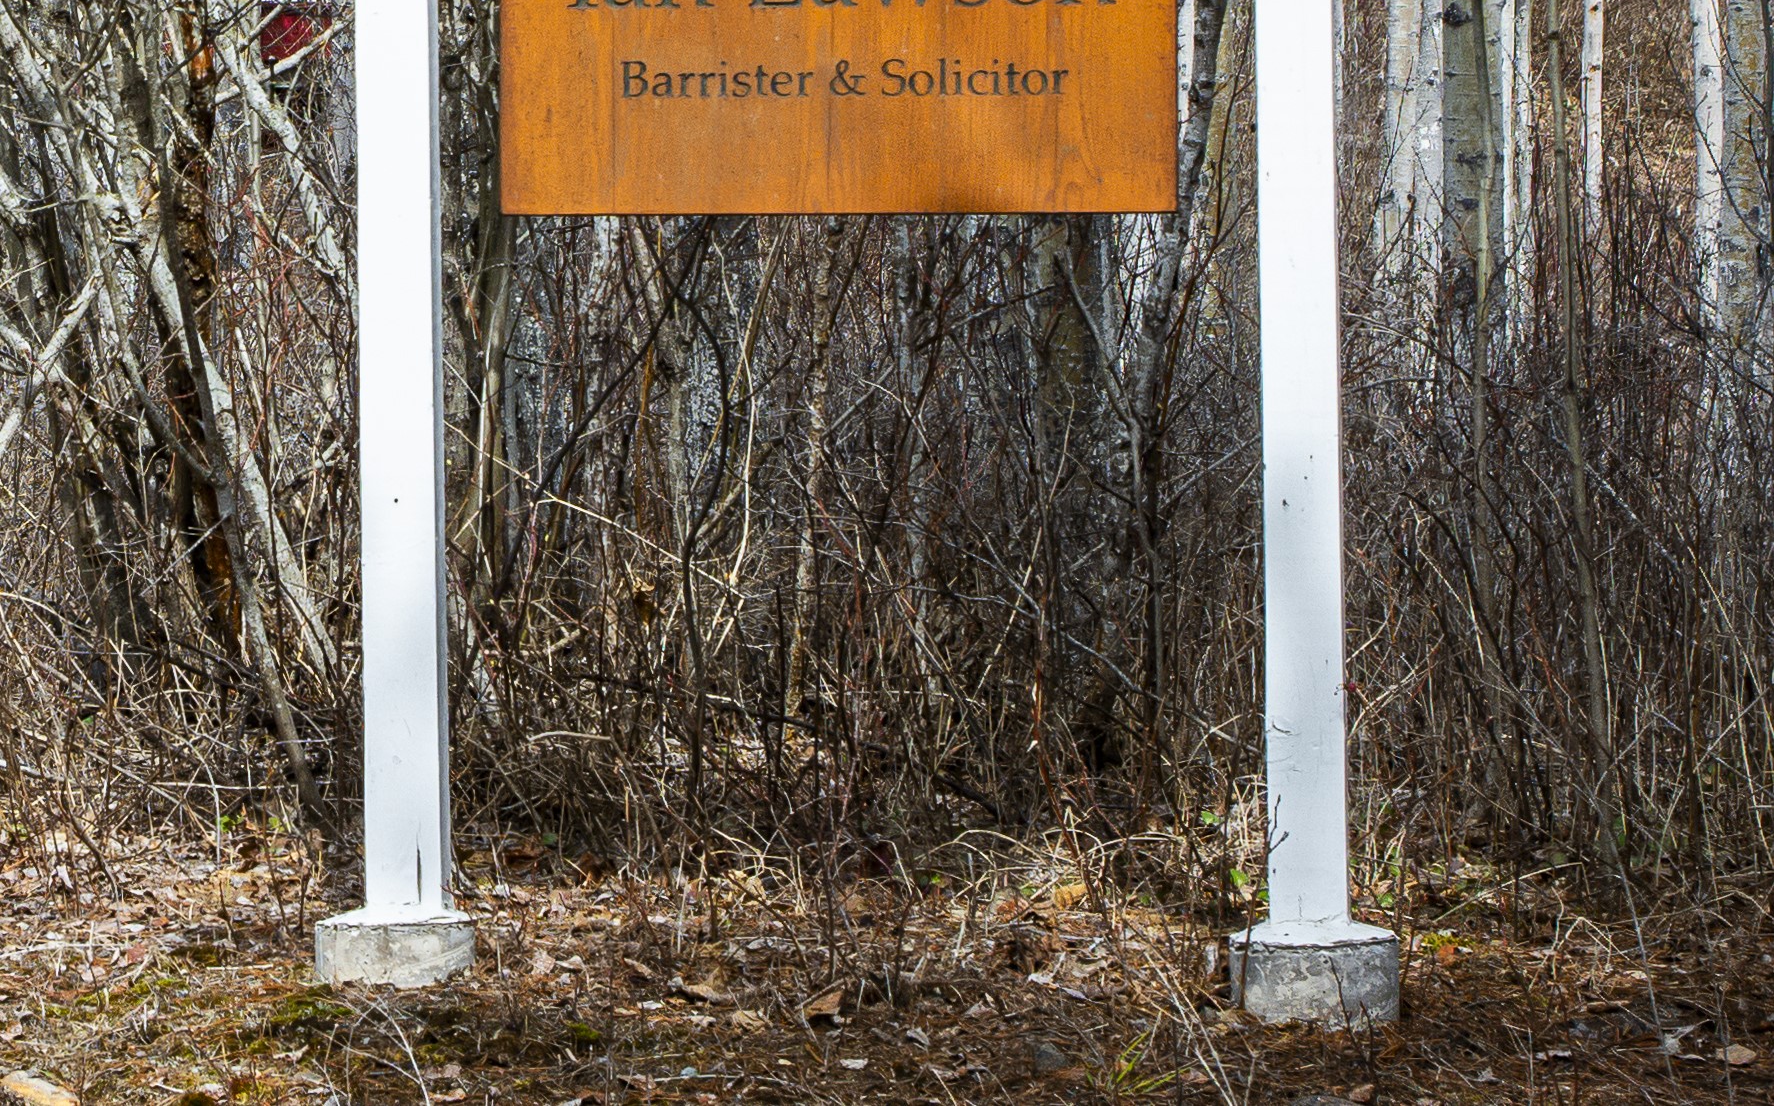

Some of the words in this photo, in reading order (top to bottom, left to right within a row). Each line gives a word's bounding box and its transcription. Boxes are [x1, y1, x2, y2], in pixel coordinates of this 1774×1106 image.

[620, 59, 815, 100] Barrister
[828, 58, 868, 98] &
[881, 57, 1070, 97] Solicitor
